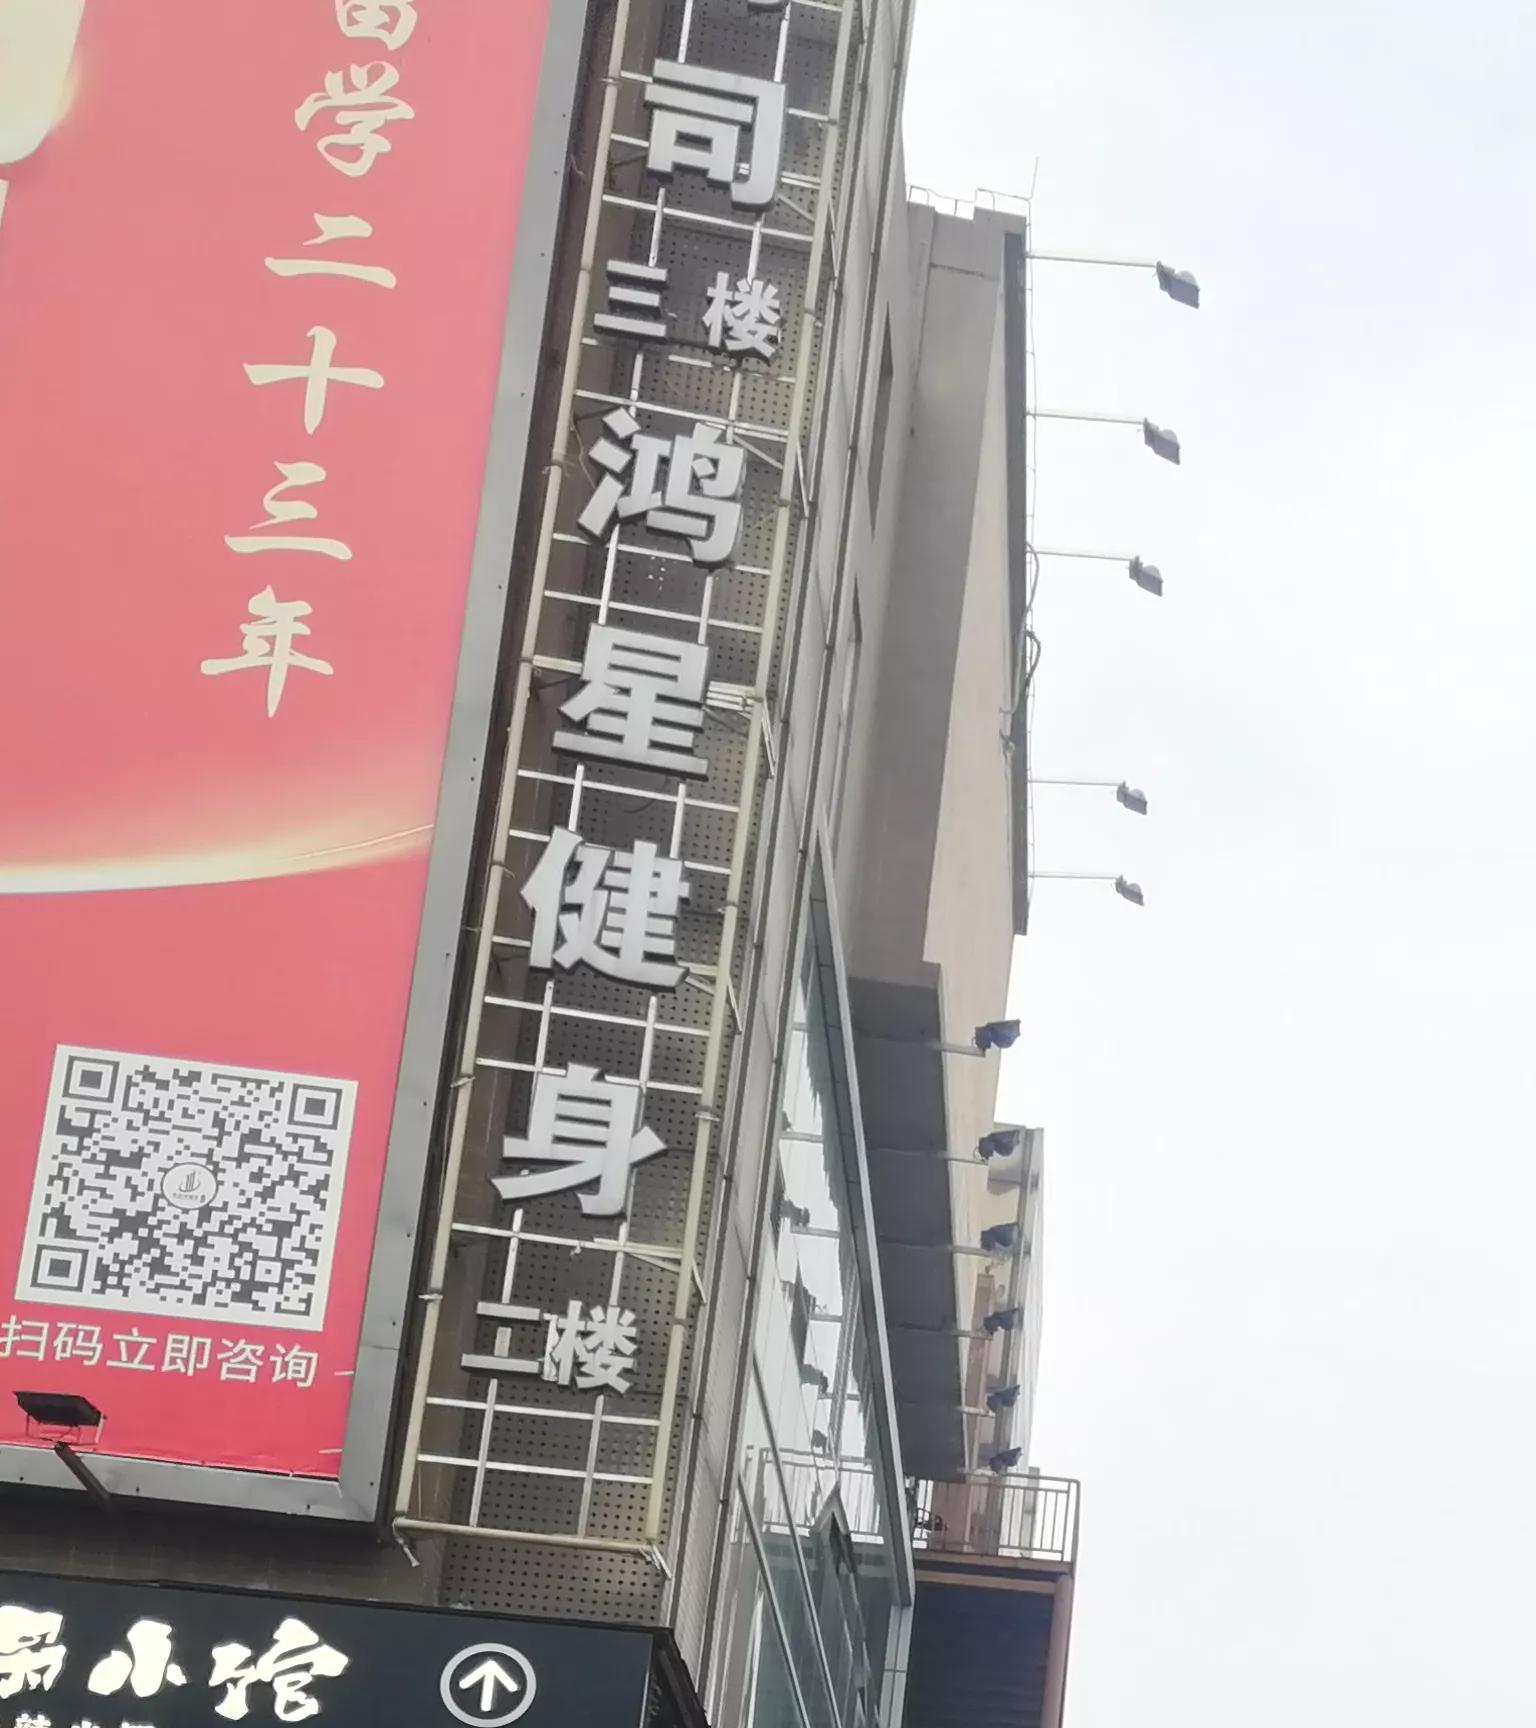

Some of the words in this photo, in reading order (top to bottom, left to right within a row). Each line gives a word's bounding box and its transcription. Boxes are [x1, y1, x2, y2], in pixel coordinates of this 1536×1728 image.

[645, 60, 786, 212] 司
[594, 258, 782, 358] 三楼
[489, 408, 748, 1217] 鸿星健身
[0, 1314, 319, 1388] 扫码立即咨询
[461, 1301, 638, 1394] 二楼
